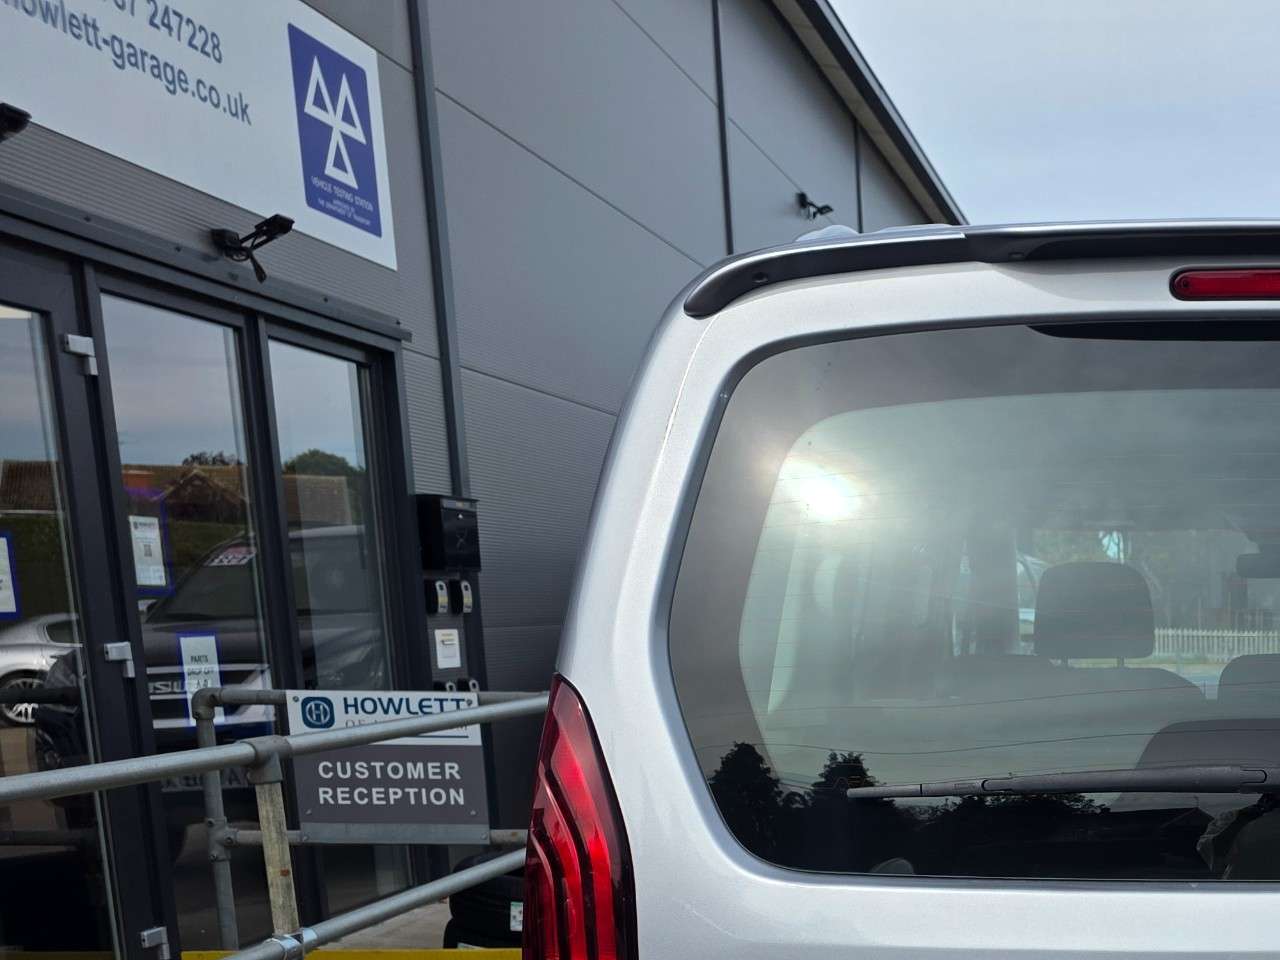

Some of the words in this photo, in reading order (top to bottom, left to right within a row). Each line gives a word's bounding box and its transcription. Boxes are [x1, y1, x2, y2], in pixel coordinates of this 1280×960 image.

[147, 0, 223, 64] 247228
[343, 697, 466, 715] HOWLETT
[318, 762, 462, 780] CUSTOMER
[318, 787, 465, 806] RECEPTION
